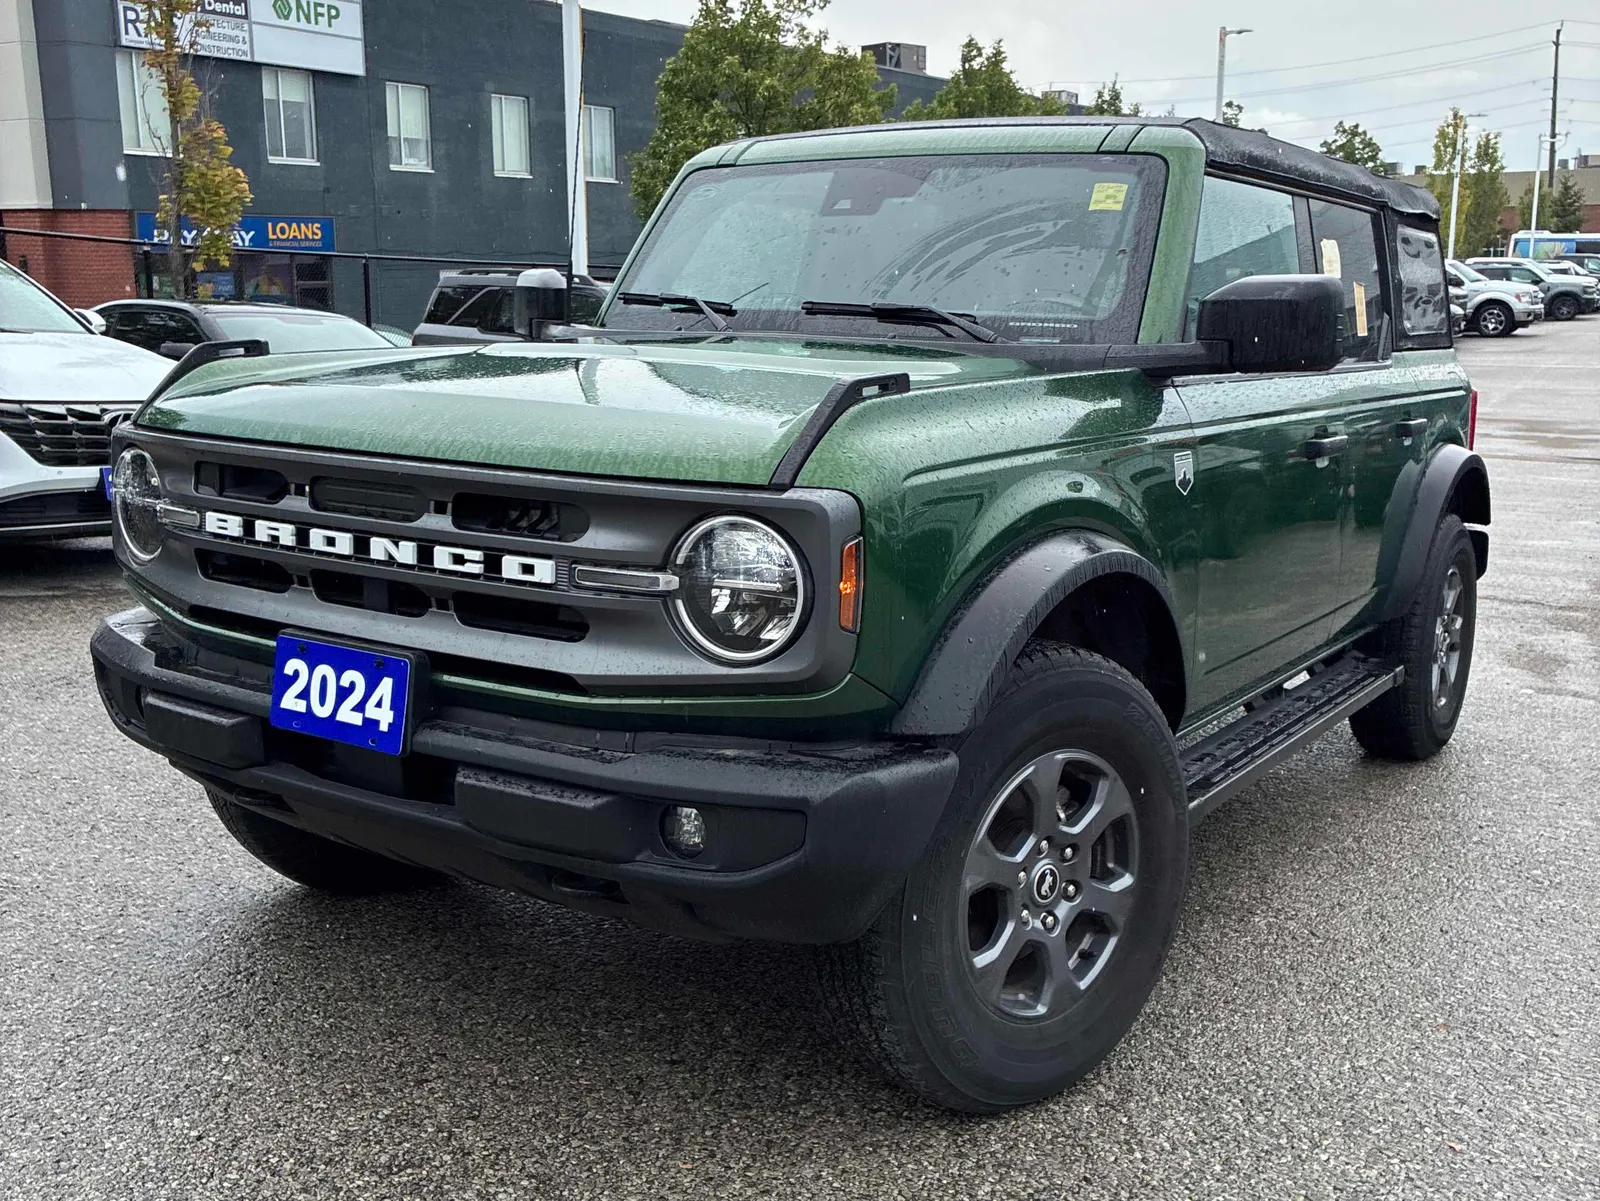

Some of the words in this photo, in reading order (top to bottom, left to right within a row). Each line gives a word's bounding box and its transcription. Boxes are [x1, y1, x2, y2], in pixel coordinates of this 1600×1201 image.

[204, 0, 246, 16] Dental
[295, 0, 340, 28] NFP
[267, 222, 322, 240] LOANS
[205, 511, 556, 584] BRONCO
[280, 658, 394, 732] 2024
